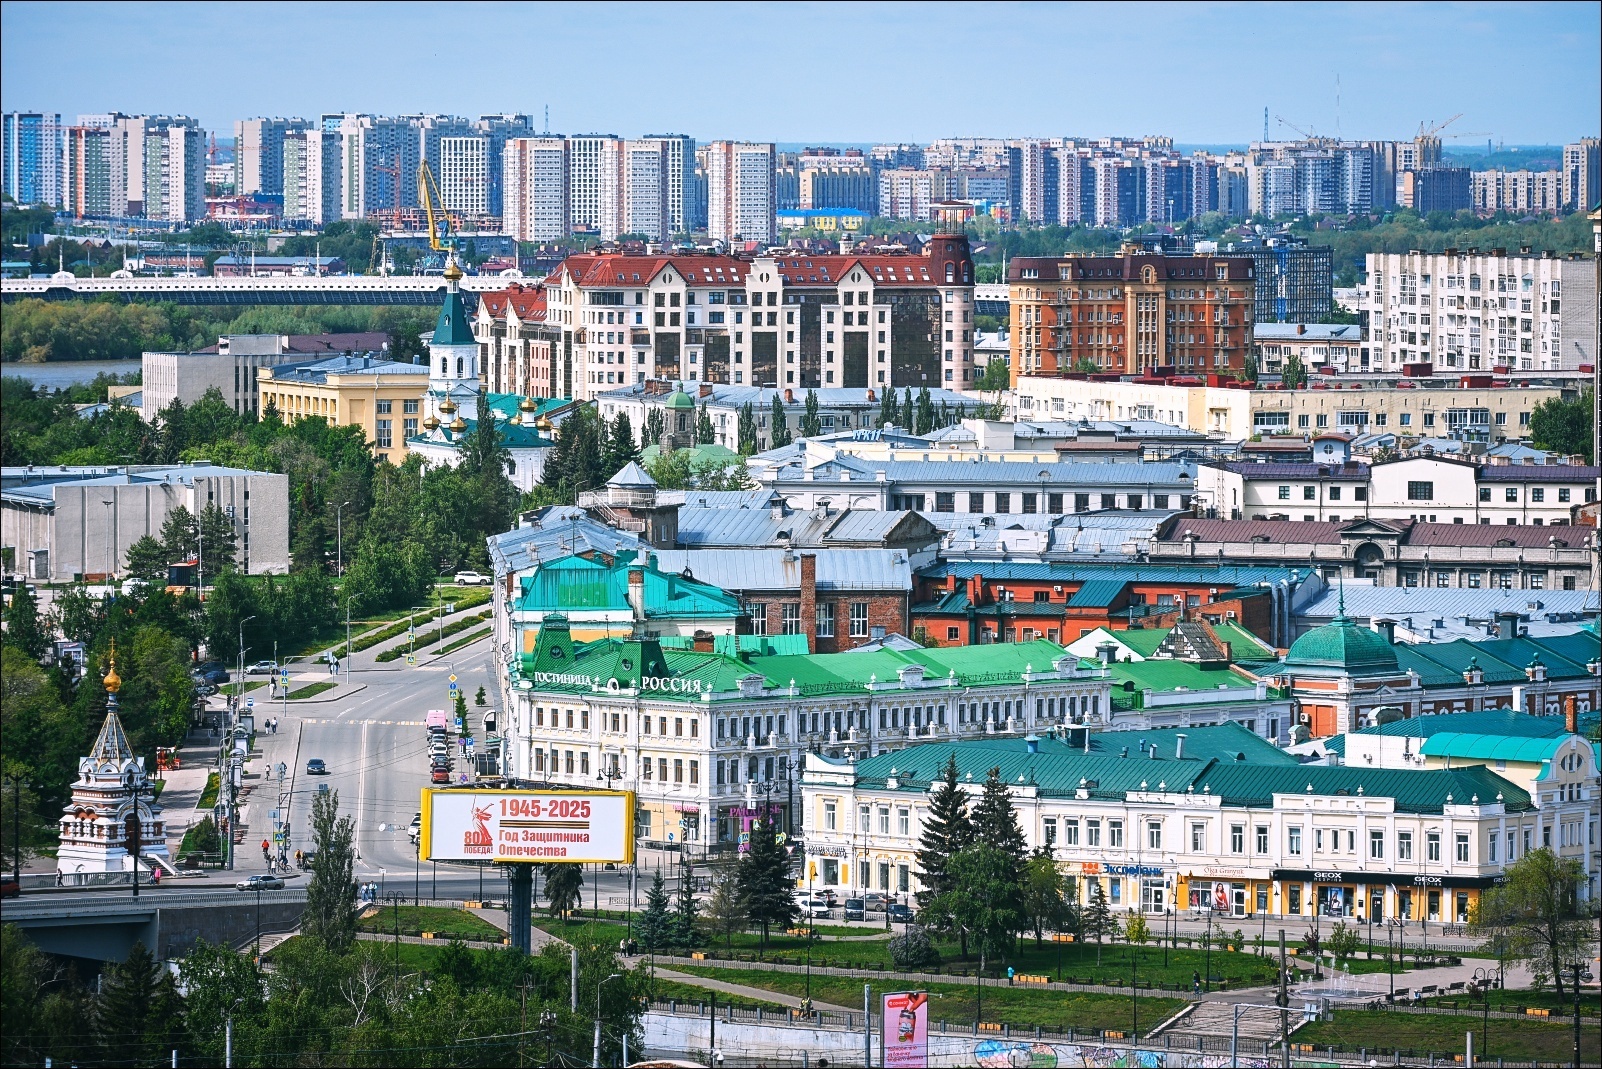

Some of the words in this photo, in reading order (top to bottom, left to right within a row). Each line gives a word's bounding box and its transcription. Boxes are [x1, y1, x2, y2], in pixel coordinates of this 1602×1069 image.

[534, 671, 592, 686] ГОСТИНИЦА
[641, 676, 701, 693] РОССИЯ
[499, 798, 591, 819] 1945-2025
[729, 804, 782, 817] PARADSE
[464, 831, 481, 845] 80
[499, 829, 519, 843] Год
[522, 831, 590, 844] Защитника
[463, 846, 494, 855] ПОБЕДА!
[498, 843, 567, 857] Отечества
[1102, 862, 1163, 876] Экспобанк
[1313, 871, 1342, 879] GEOX
[1414, 875, 1442, 883] GEOX
